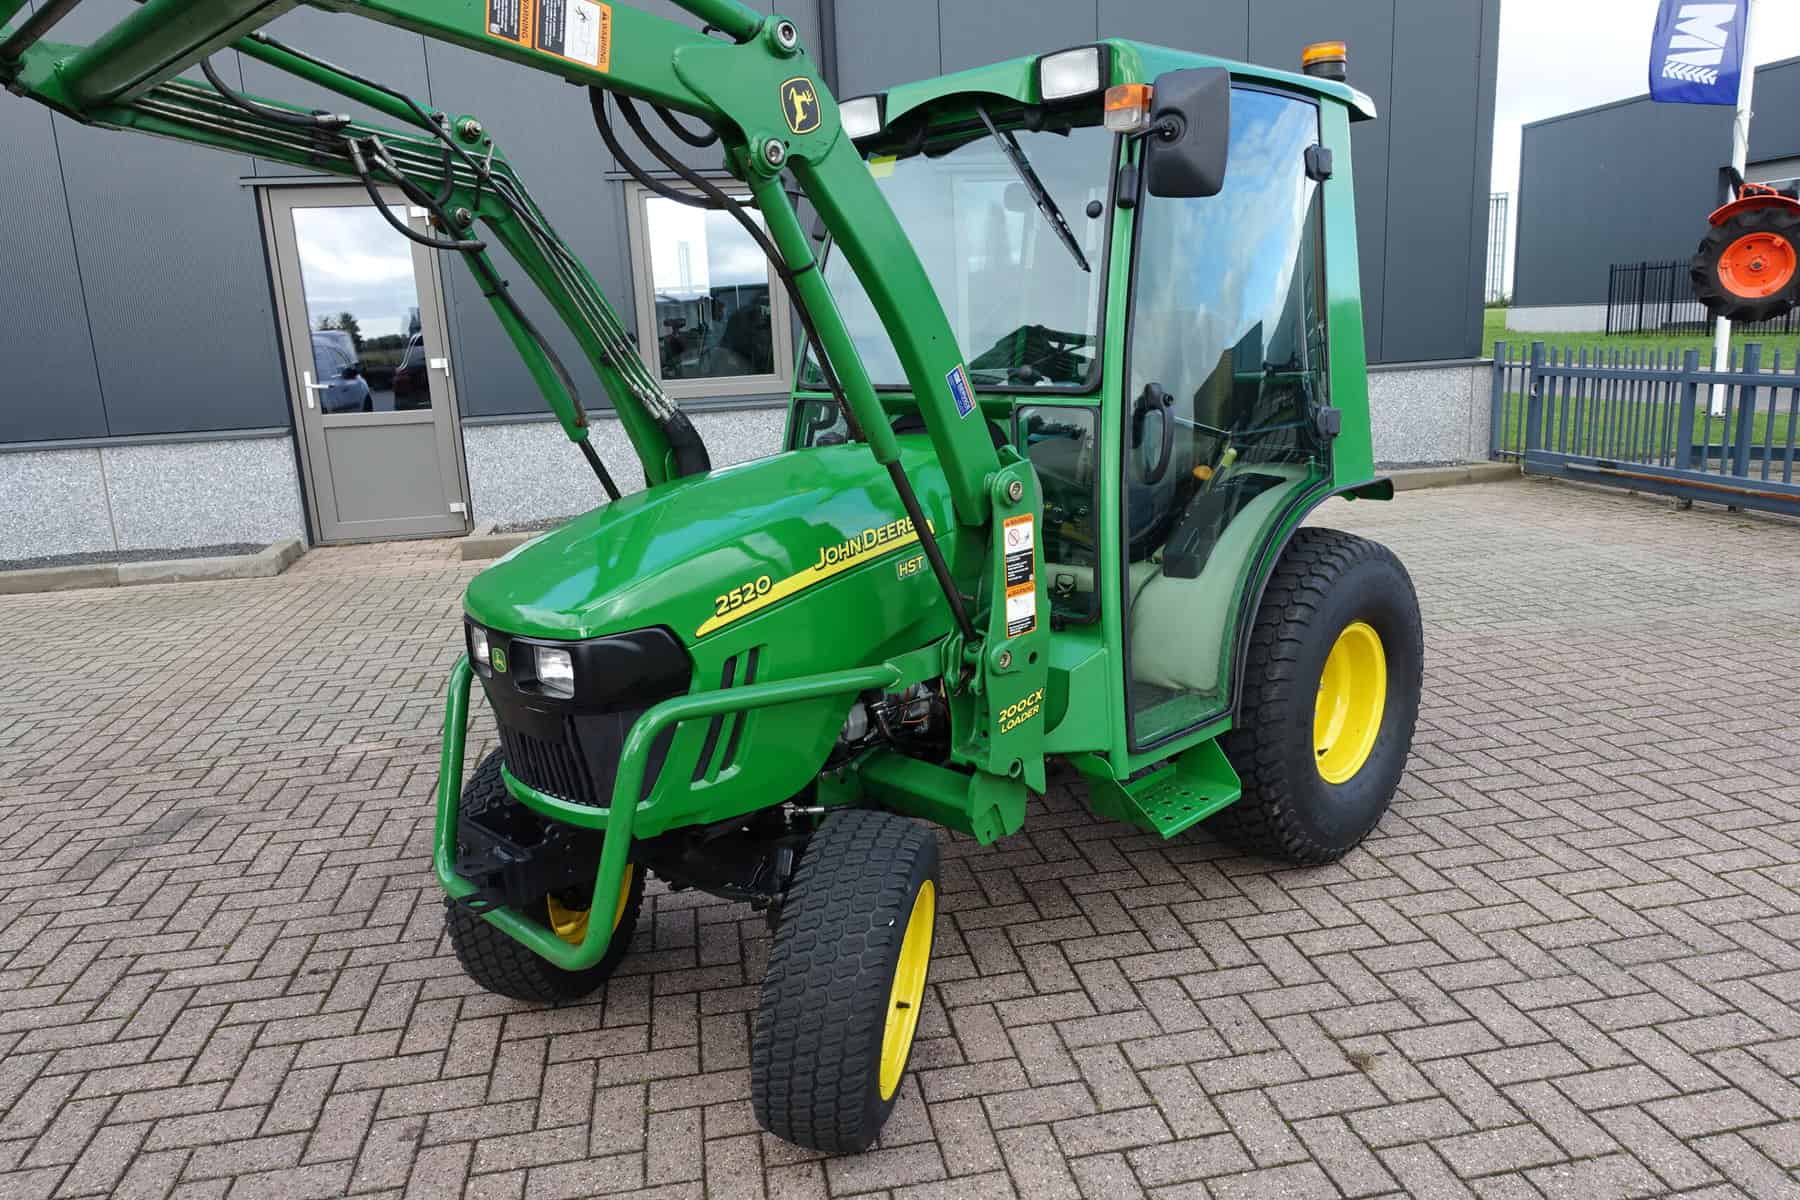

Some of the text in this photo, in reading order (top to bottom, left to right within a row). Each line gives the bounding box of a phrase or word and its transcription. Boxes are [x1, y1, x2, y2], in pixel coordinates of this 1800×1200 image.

[814, 534, 863, 570] JOHN
[899, 556, 924, 577] HST
[715, 575, 773, 616] 2520
[998, 687, 1044, 723] 200CX
[1001, 704, 1040, 734] LOADER
